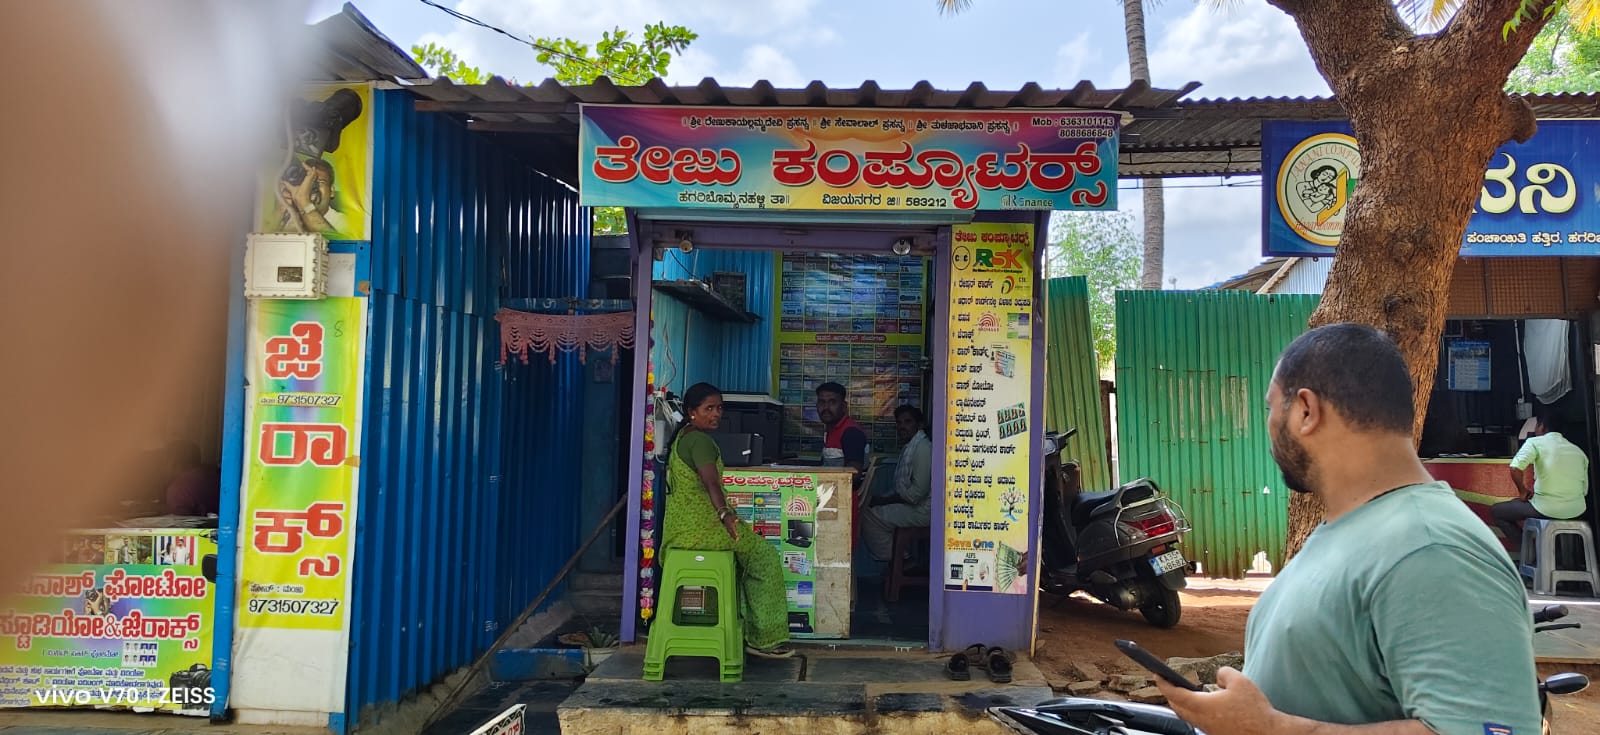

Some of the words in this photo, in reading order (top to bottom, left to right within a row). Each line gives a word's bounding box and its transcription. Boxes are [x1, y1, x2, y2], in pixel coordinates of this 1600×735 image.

[1032, 118, 1052, 126] Mob
[1060, 118, 1113, 127] 6363101143
[593, 135, 742, 186] ತೇಜು
[772, 138, 1108, 211] ಕಂಪ್ಯೂಟರ್ಸ್
[1472, 151, 1577, 214] ನನಿ
[822, 193, 882, 205] ವಿಜಯನಗರ
[905, 197, 947, 207] 583212
[1467, 231, 1527, 244] ಪಂಚಾಯಿತಿ
[278, 394, 342, 406] 9731507327
[972, 538, 995, 549] One
[249, 599, 339, 615] 9731507327
